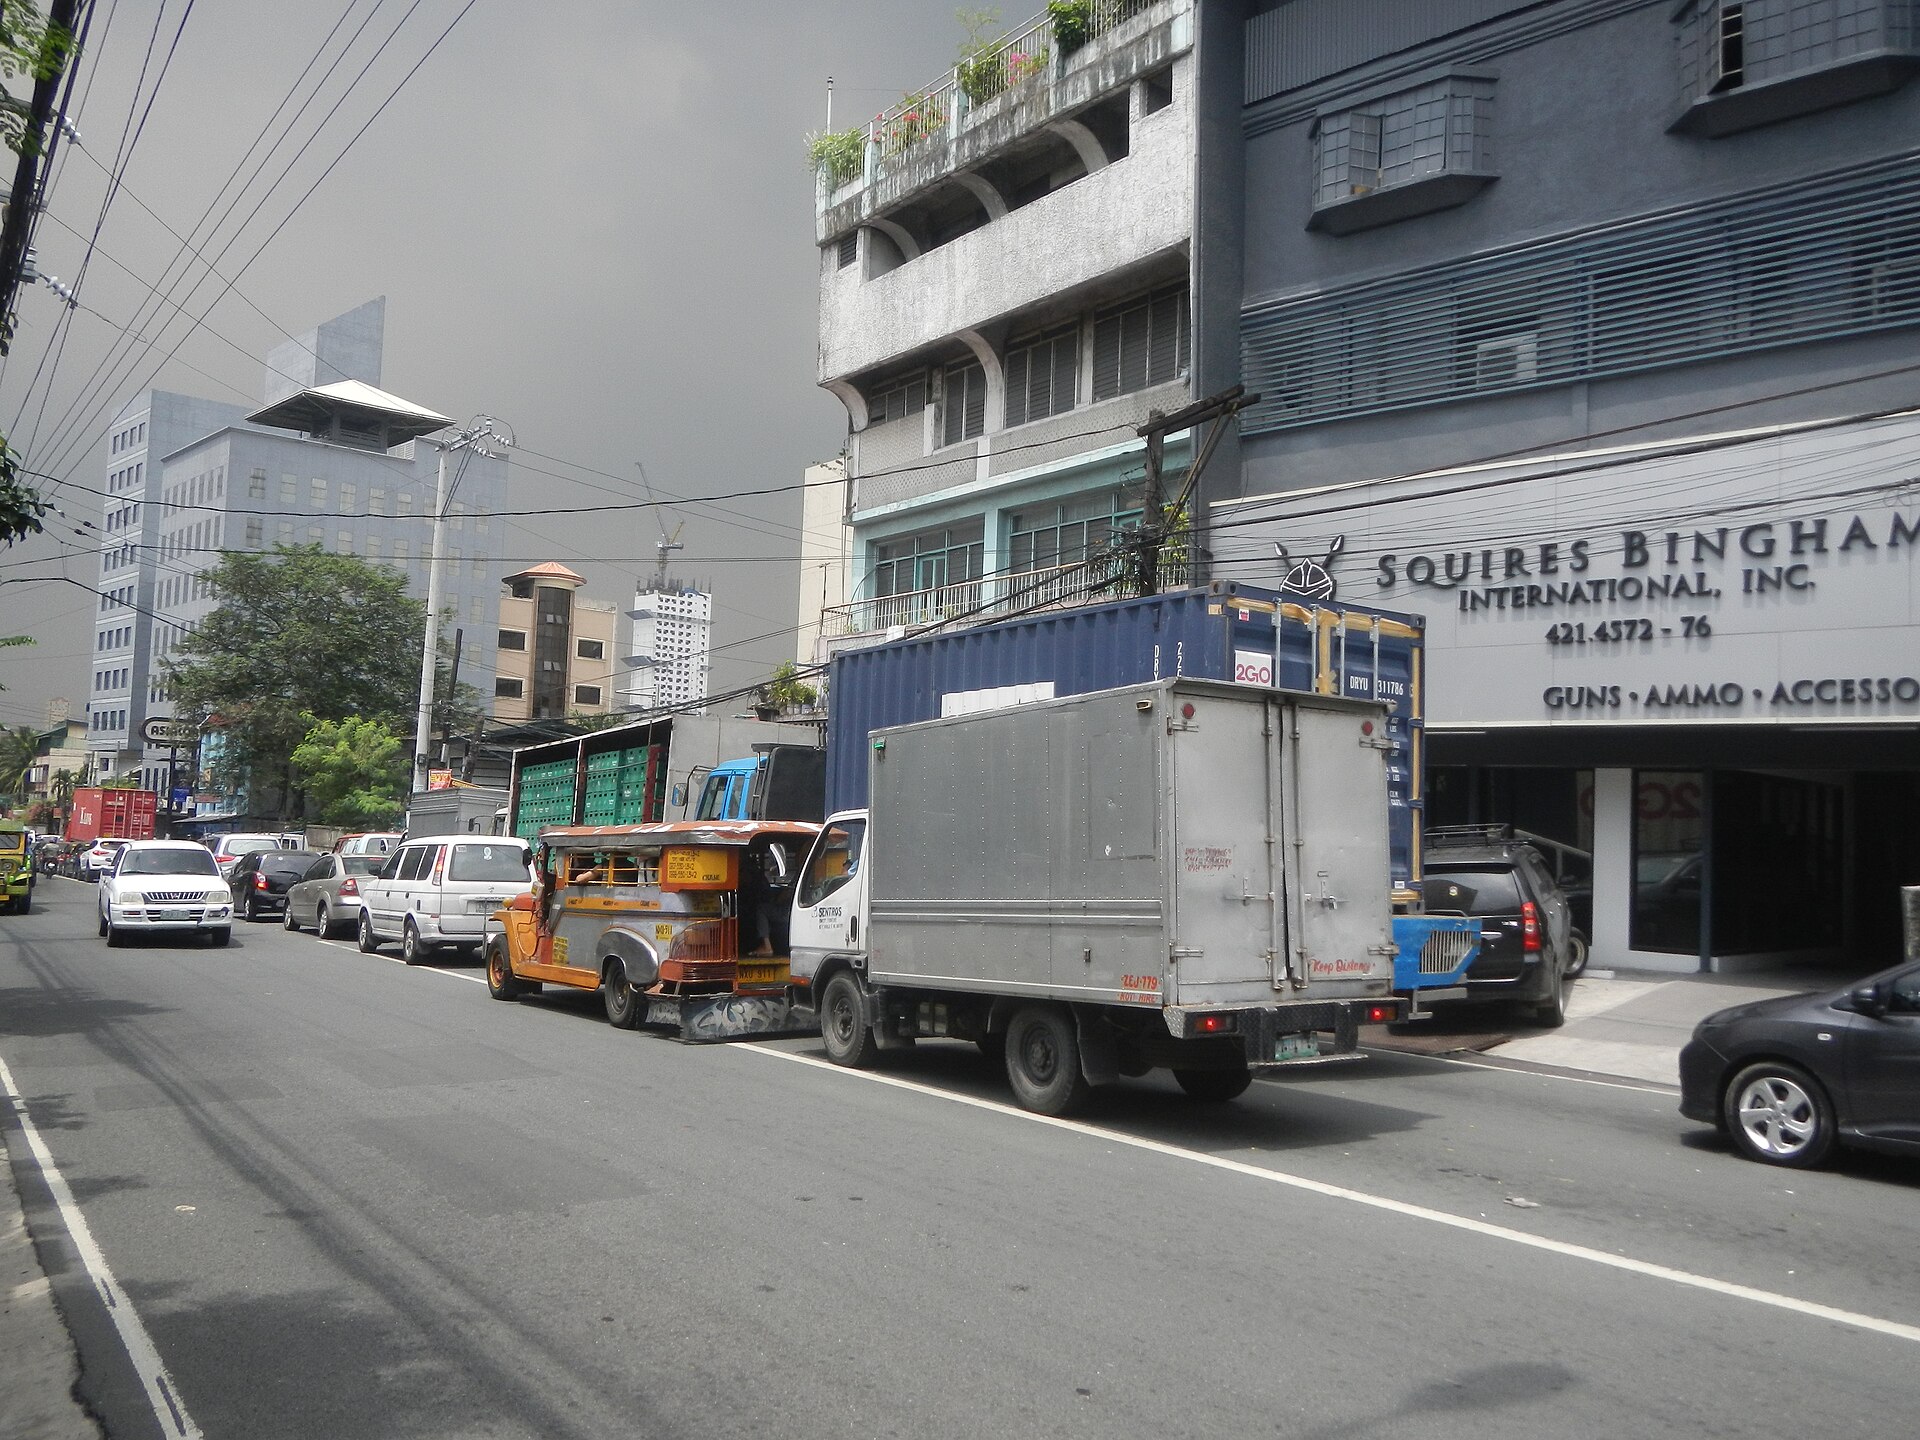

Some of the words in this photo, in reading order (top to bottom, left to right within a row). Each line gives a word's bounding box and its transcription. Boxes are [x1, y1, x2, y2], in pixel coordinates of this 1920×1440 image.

[1377, 540, 1589, 589] SQUIRES
[1621, 511, 1920, 568] BINGHAM
[1459, 572, 1721, 611] INTERNATIONAL,
[1742, 564, 1815, 594] INC.
[1545, 617, 1653, 644] 421.4572
[1680, 615, 1712, 639] 76
[1235, 663, 1271, 684] 2GO
[1350, 675, 1369, 691] DRYU
[1377, 680, 1404, 696] 311786
[1543, 685, 1621, 710] GUNS
[1644, 682, 1743, 708] AMMO
[818, 906, 842, 918] SENTROS
